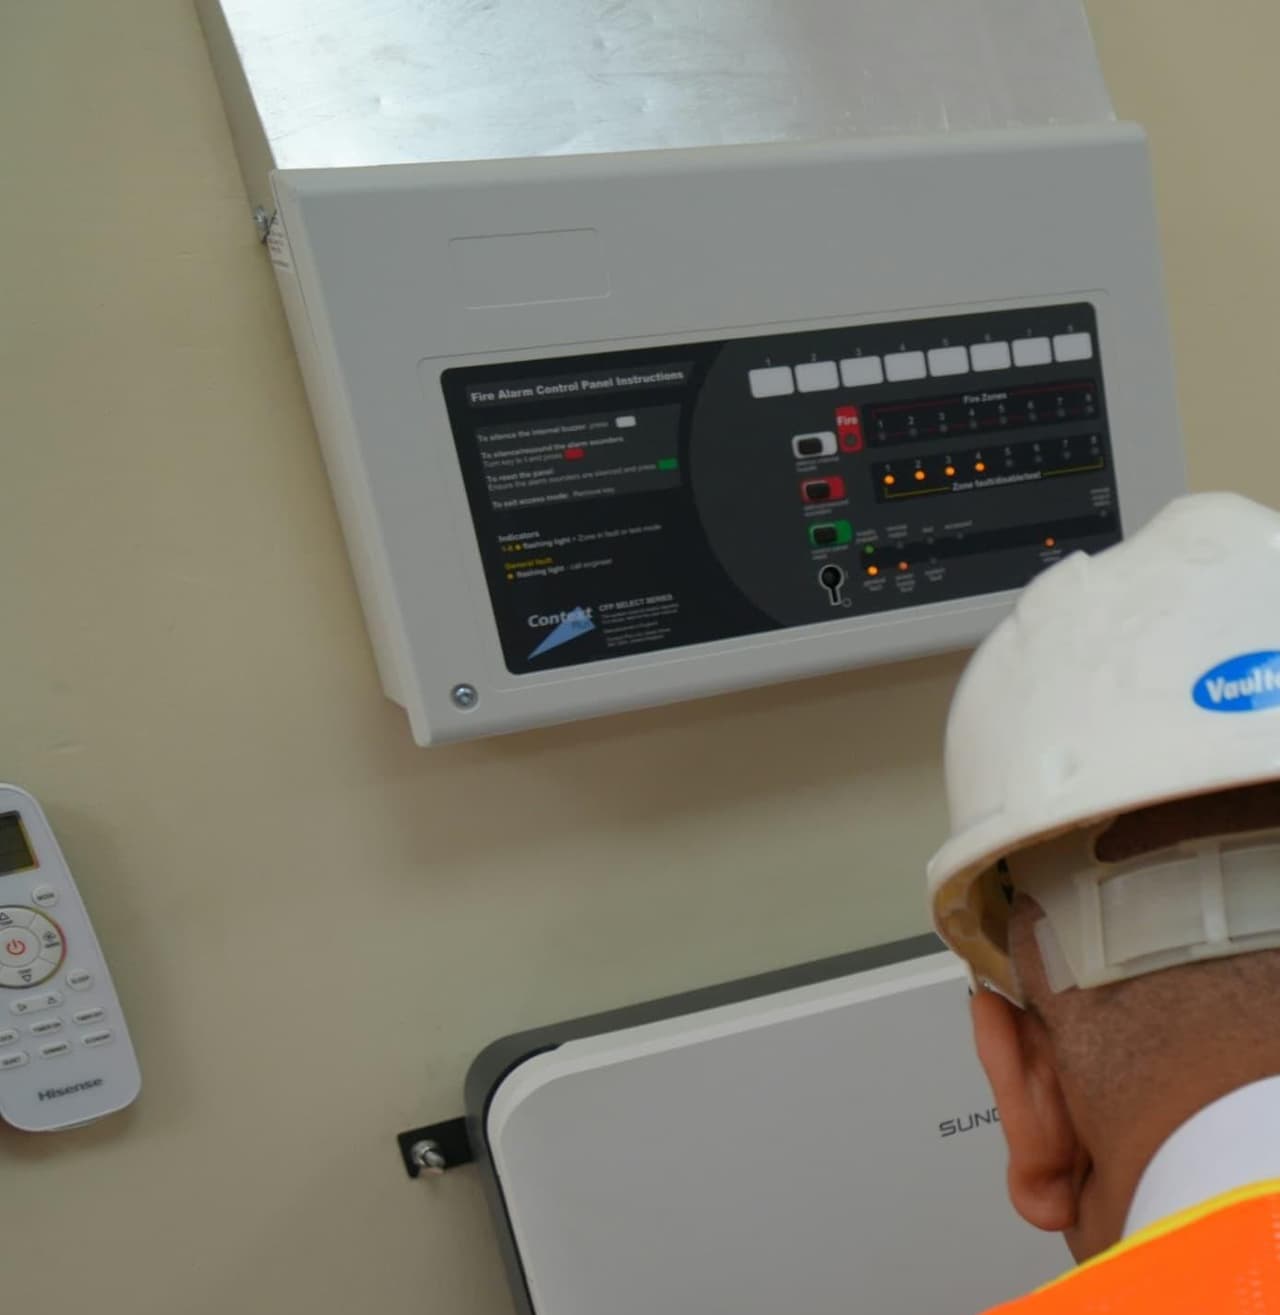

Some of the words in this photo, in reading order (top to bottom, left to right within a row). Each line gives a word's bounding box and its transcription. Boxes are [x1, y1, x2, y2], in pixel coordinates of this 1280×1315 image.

[470, 391, 495, 402] Fire
[498, 388, 533, 400] Alarm
[536, 381, 579, 395] Control
[581, 378, 613, 390] Panel
[615, 371, 684, 387] Instructions
[836, 415, 858, 426] Fire
[38, 1078, 103, 1101] Hisense
